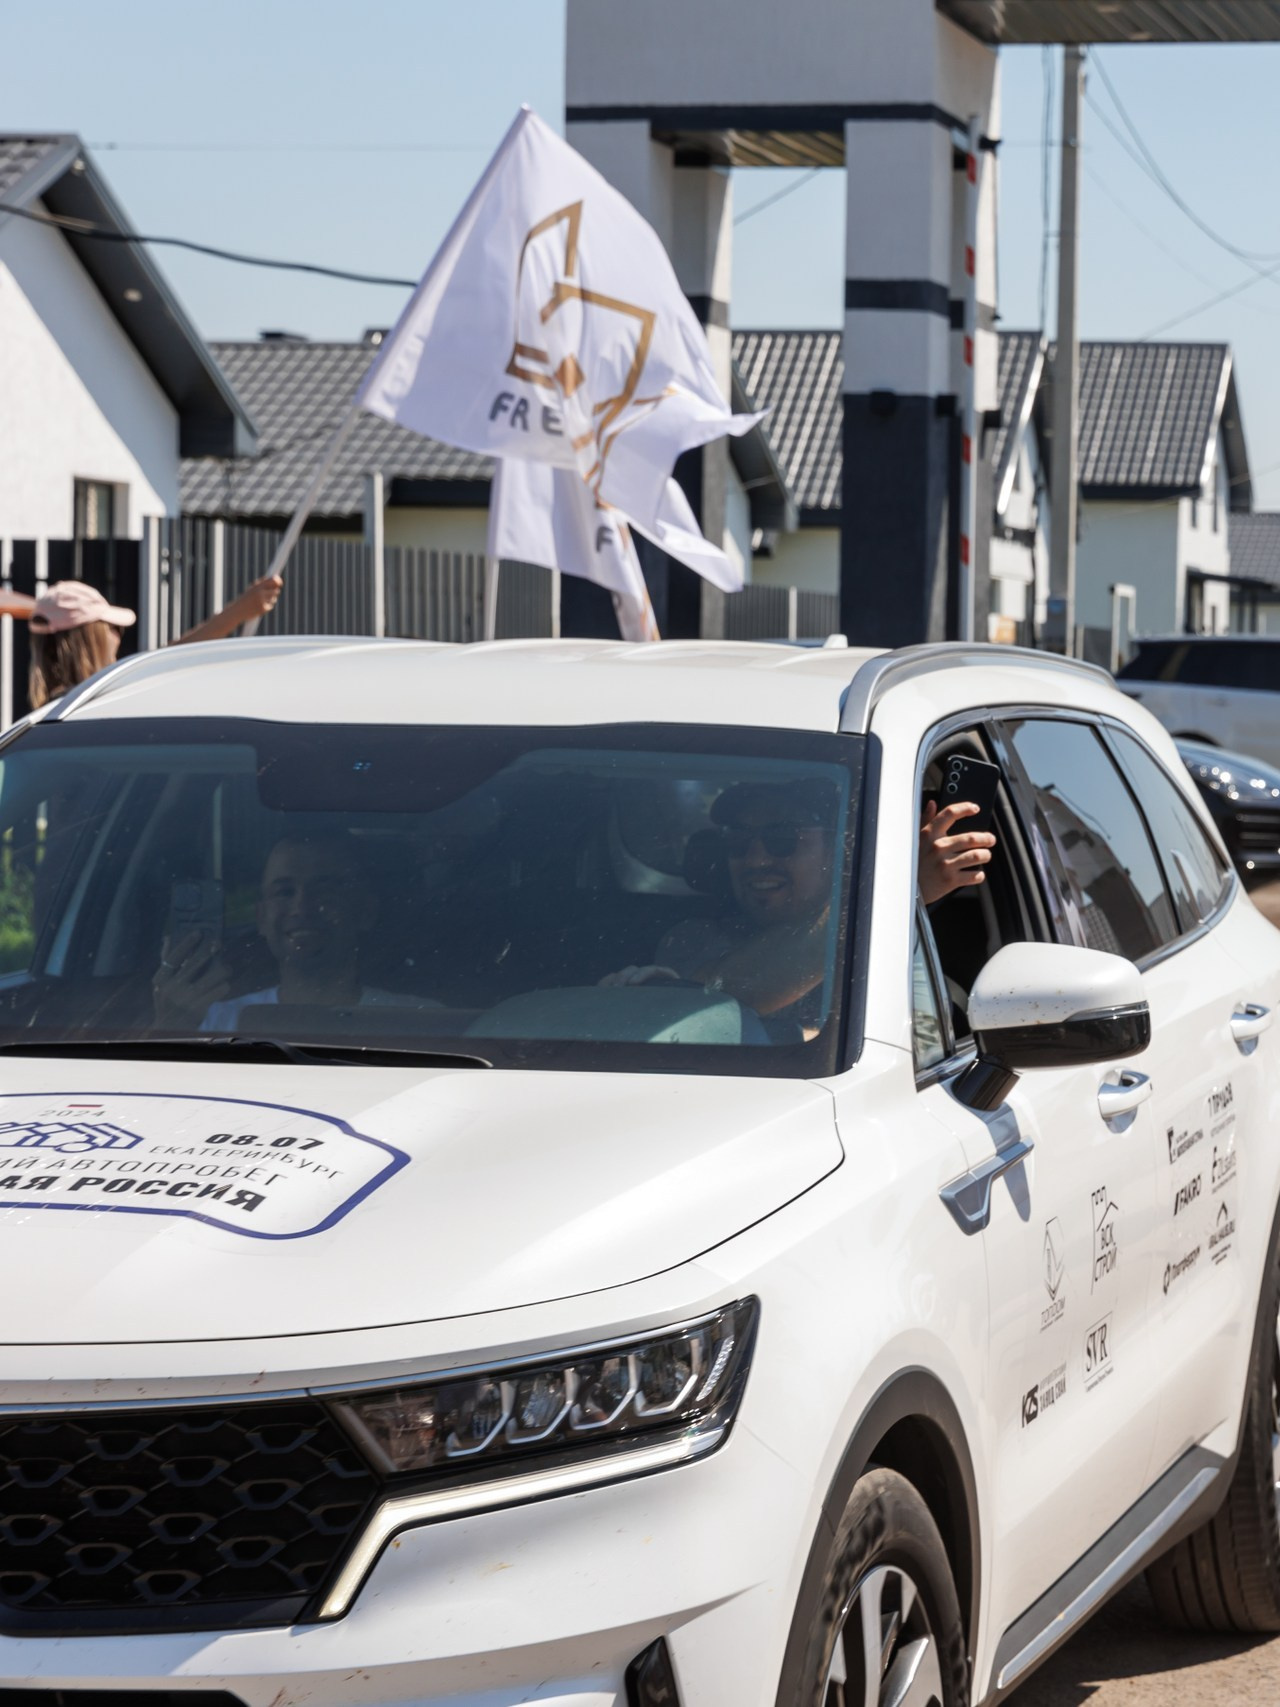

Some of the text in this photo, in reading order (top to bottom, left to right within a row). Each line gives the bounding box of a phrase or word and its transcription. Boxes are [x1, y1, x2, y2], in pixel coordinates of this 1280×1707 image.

[205, 1133, 325, 1151] 08.07
[44, 1158, 288, 1187] АВТОПРОБЕГ
[150, 1145, 344, 1179] ЕКАТЕРИНБУРГ
[66, 1176, 268, 1213] РОССИЯ
[1086, 1322, 1108, 1373] SVR
